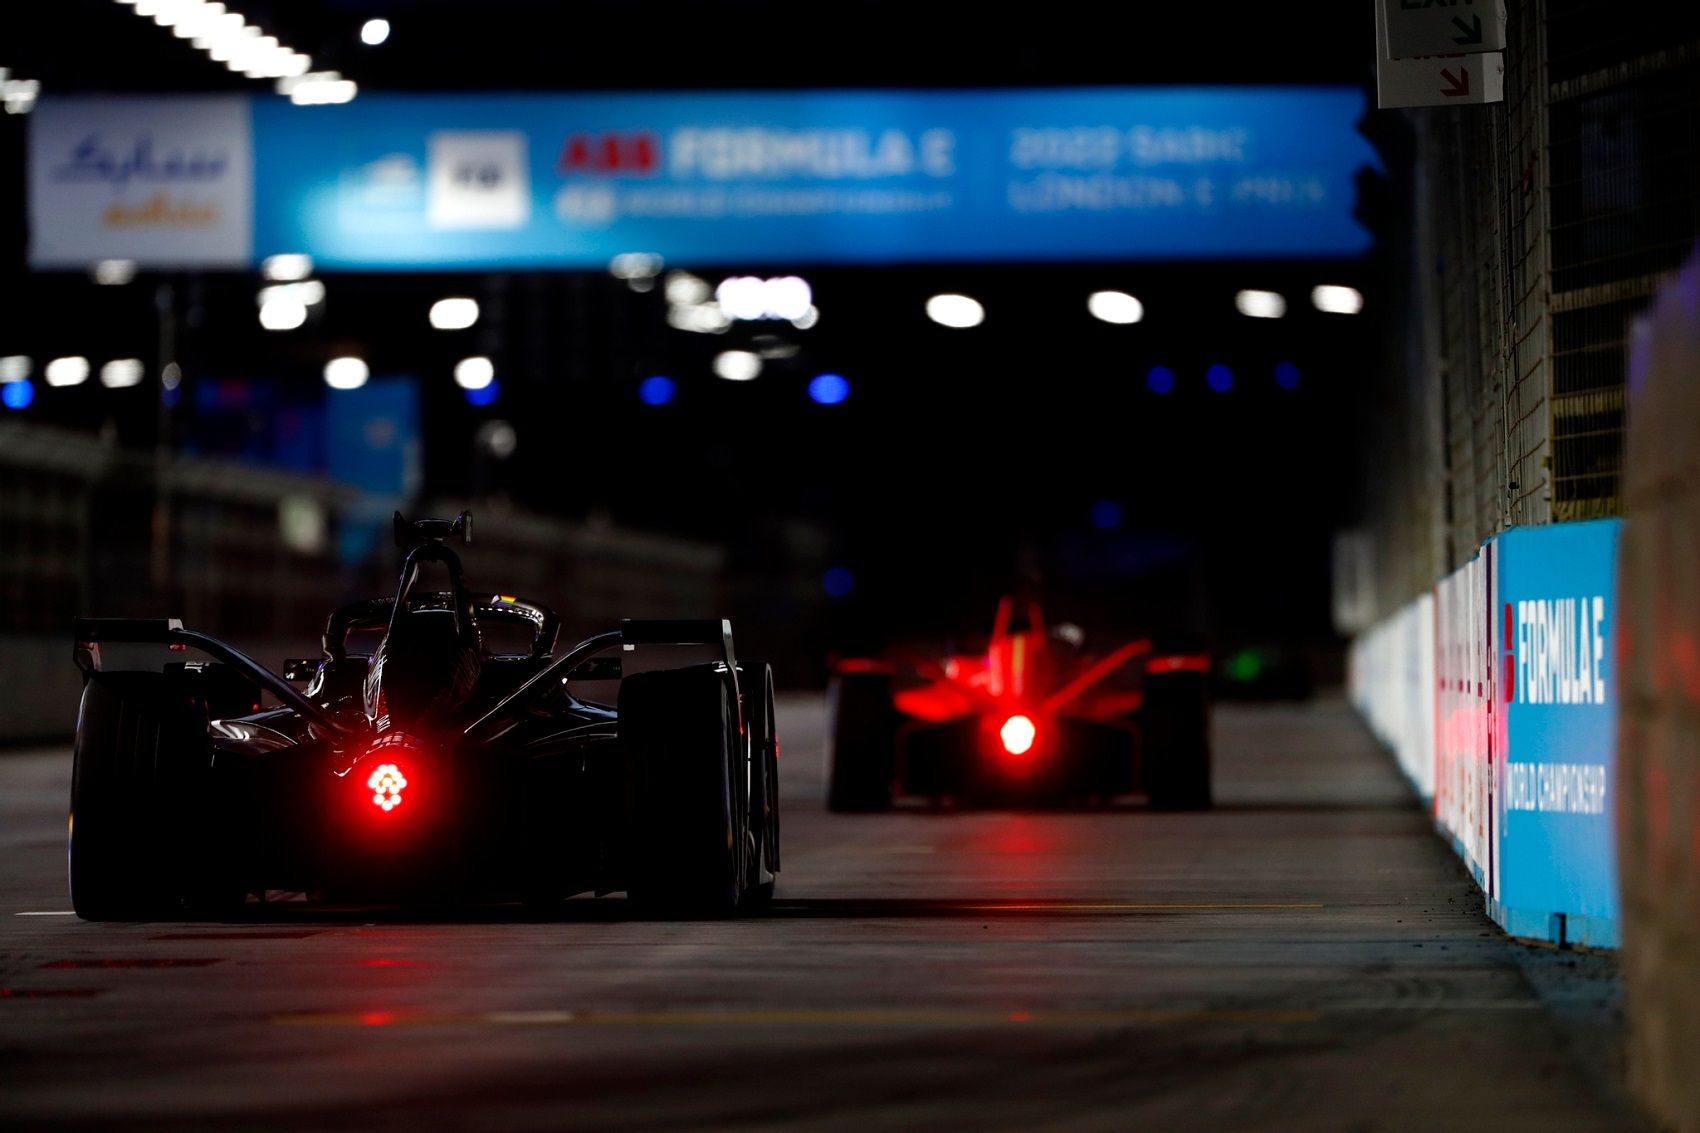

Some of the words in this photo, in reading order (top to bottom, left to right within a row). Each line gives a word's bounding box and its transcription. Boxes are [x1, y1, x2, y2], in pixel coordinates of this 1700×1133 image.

[670, 127, 913, 177] FORMULA
[920, 128, 955, 177] E
[1518, 597, 1593, 704] FORMULA
[1592, 595, 1605, 704] E
[1503, 762, 1536, 811] WORLD
[1537, 762, 1606, 814] CHAMPIONSHIP
